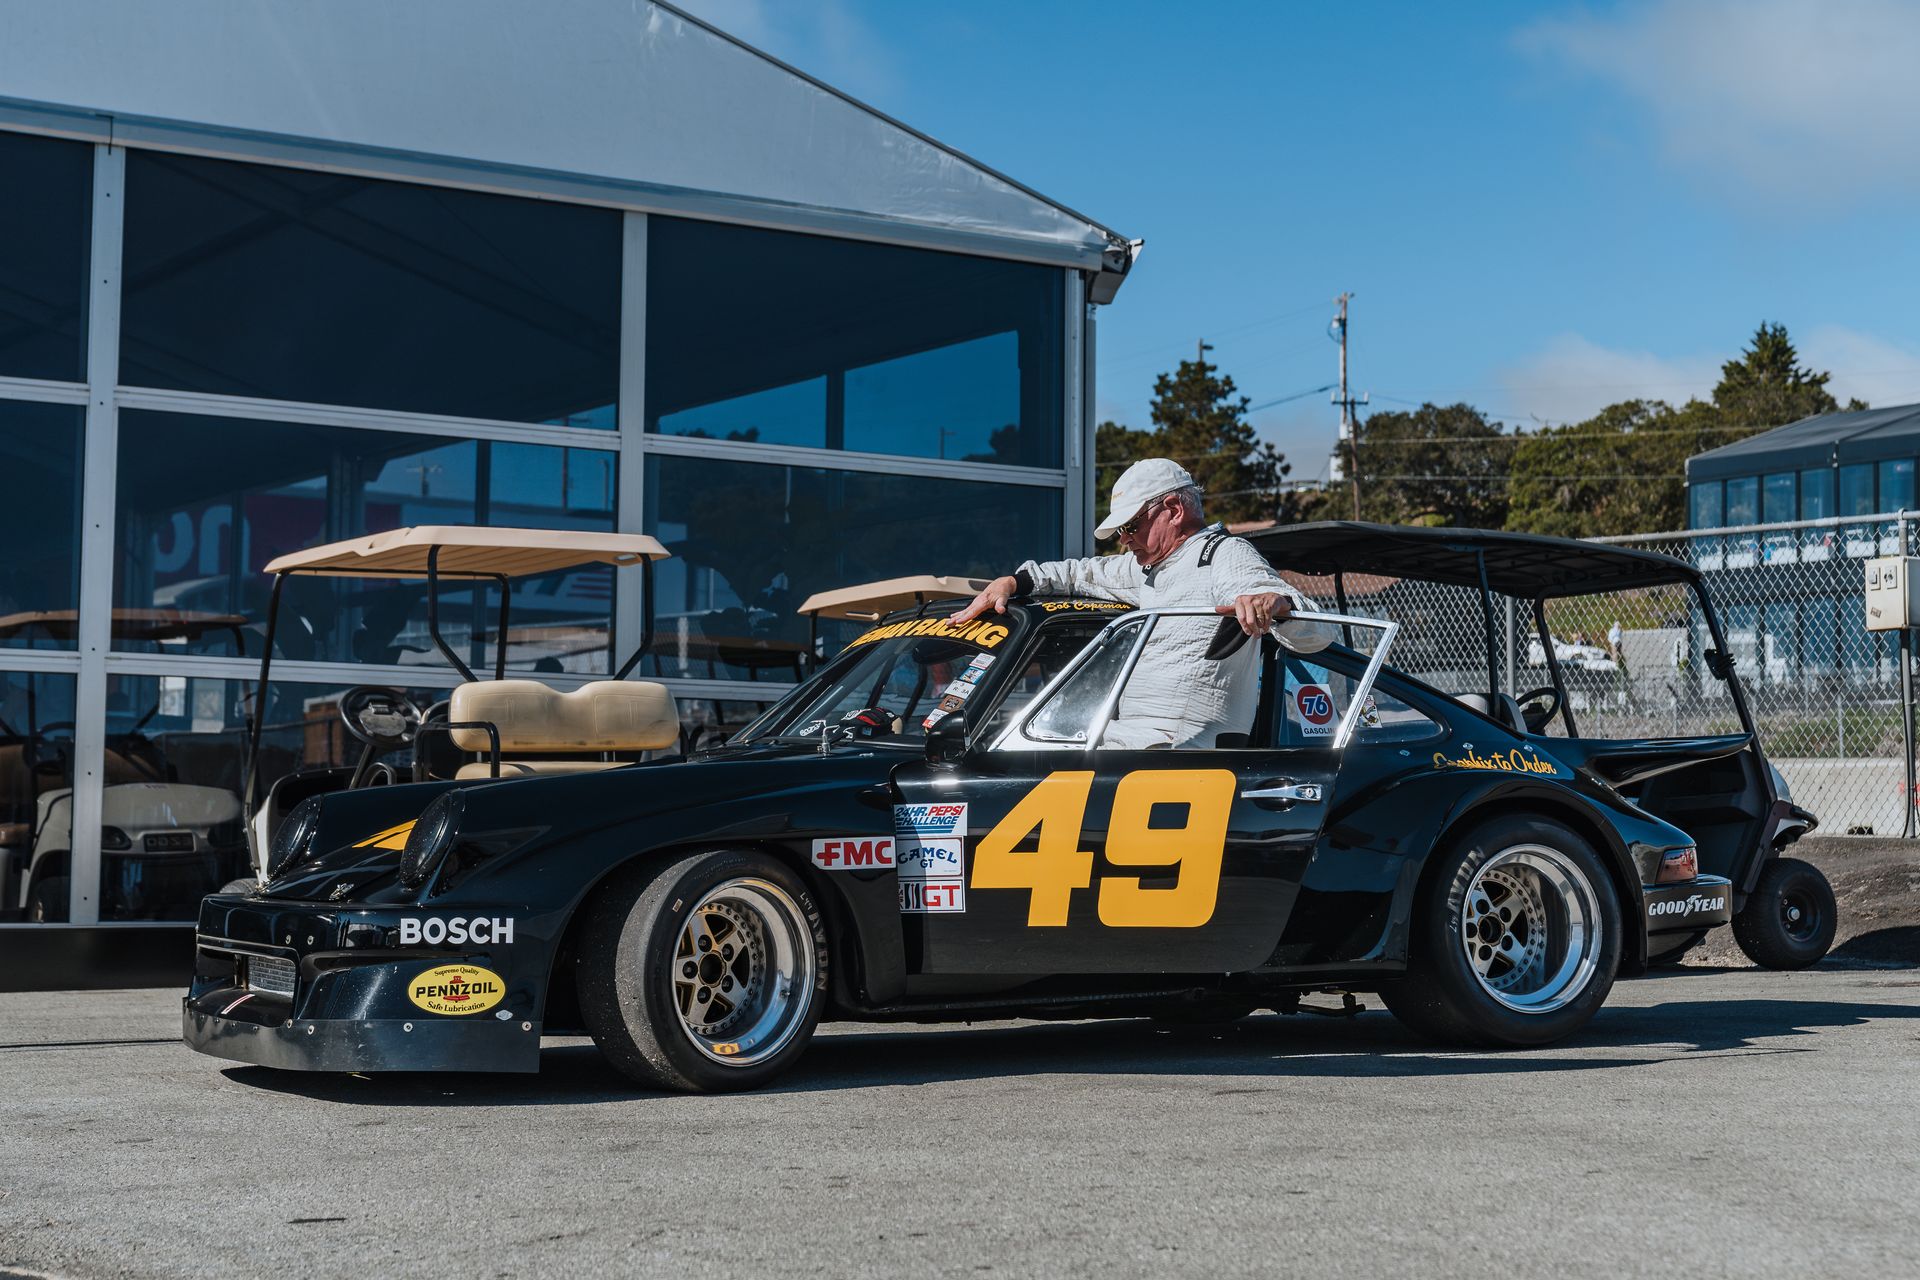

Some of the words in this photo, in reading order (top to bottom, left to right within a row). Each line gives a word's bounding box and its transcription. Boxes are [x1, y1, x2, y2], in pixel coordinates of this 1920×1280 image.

[1042, 602, 1071, 612] Bob
[1073, 601, 1131, 611] Copeman
[909, 618, 1009, 648] RACING
[1302, 694, 1329, 716] 76
[1303, 727, 1337, 735] GASOLIN
[1491, 752, 1510, 770] to
[1510, 749, 1557, 775] Order
[928, 806, 965, 816] PEPSI
[816, 841, 892, 866] FMC
[897, 847, 957, 864] CAMEL
[970, 769, 1237, 928] 49
[920, 859, 934, 868] GT
[922, 885, 961, 907] GT
[400, 917, 514, 944] BOSCH
[460, 967, 480, 976] Quality
[416, 982, 498, 998] PENNZOIL
[427, 1001, 443, 1011] Safe
[444, 1002, 486, 1012] Lubrication
